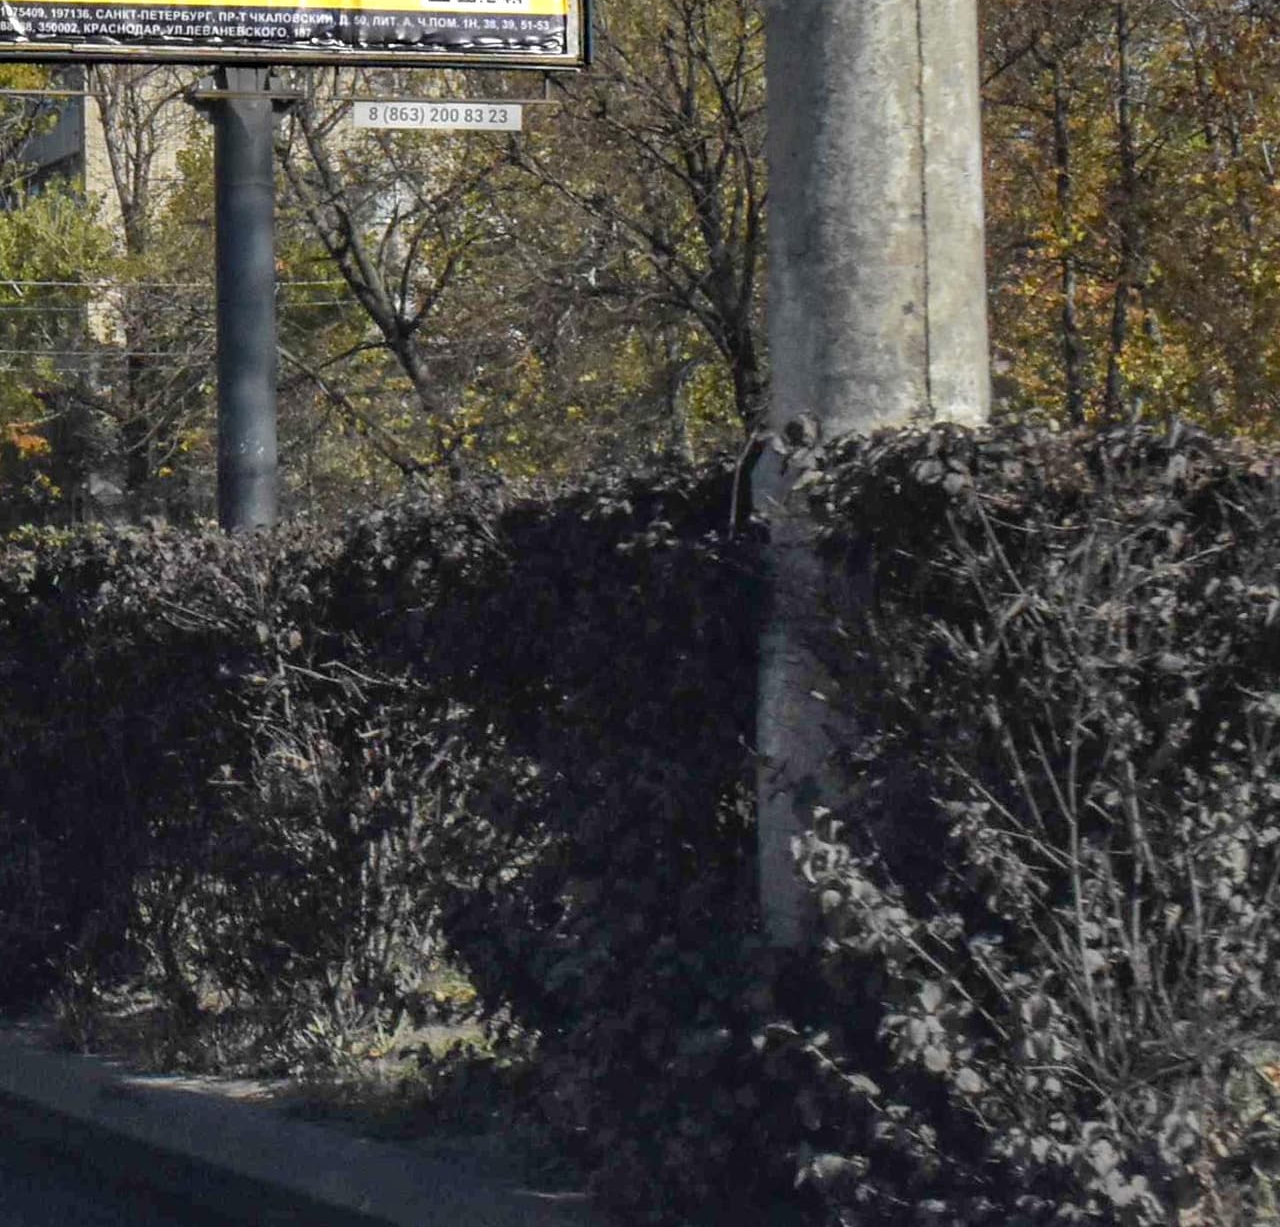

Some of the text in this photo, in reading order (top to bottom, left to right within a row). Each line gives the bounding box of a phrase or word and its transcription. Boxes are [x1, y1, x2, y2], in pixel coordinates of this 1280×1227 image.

[219, 12, 246, 22] ПР-Т
[521, 20, 549, 31] 51-53
[369, 106, 508, 124] 8 (863) 200 83 23
